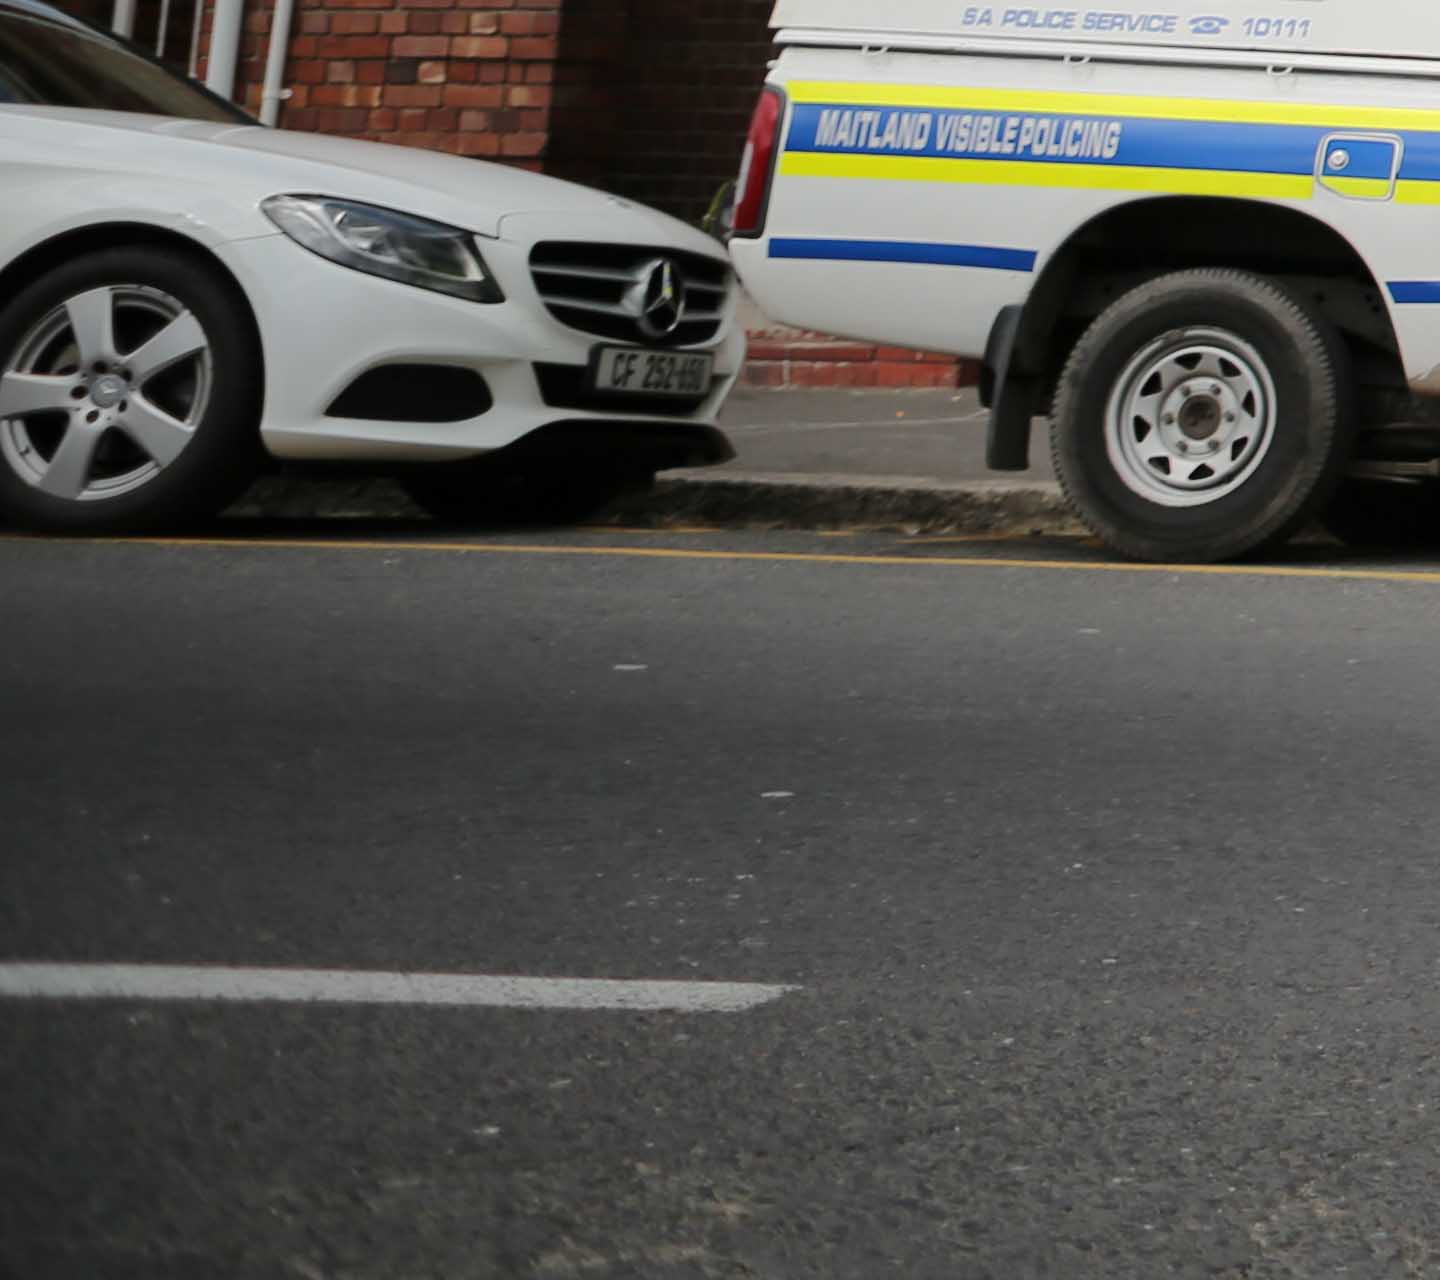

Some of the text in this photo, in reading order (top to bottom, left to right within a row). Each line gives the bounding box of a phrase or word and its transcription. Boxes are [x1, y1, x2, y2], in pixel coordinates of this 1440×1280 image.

[961, 7, 1313, 38] SA POLICE SERVICE 10111
[814, 108, 1122, 159] MAITLAND VISIBLE POLICING
[609, 352, 639, 388] CF
